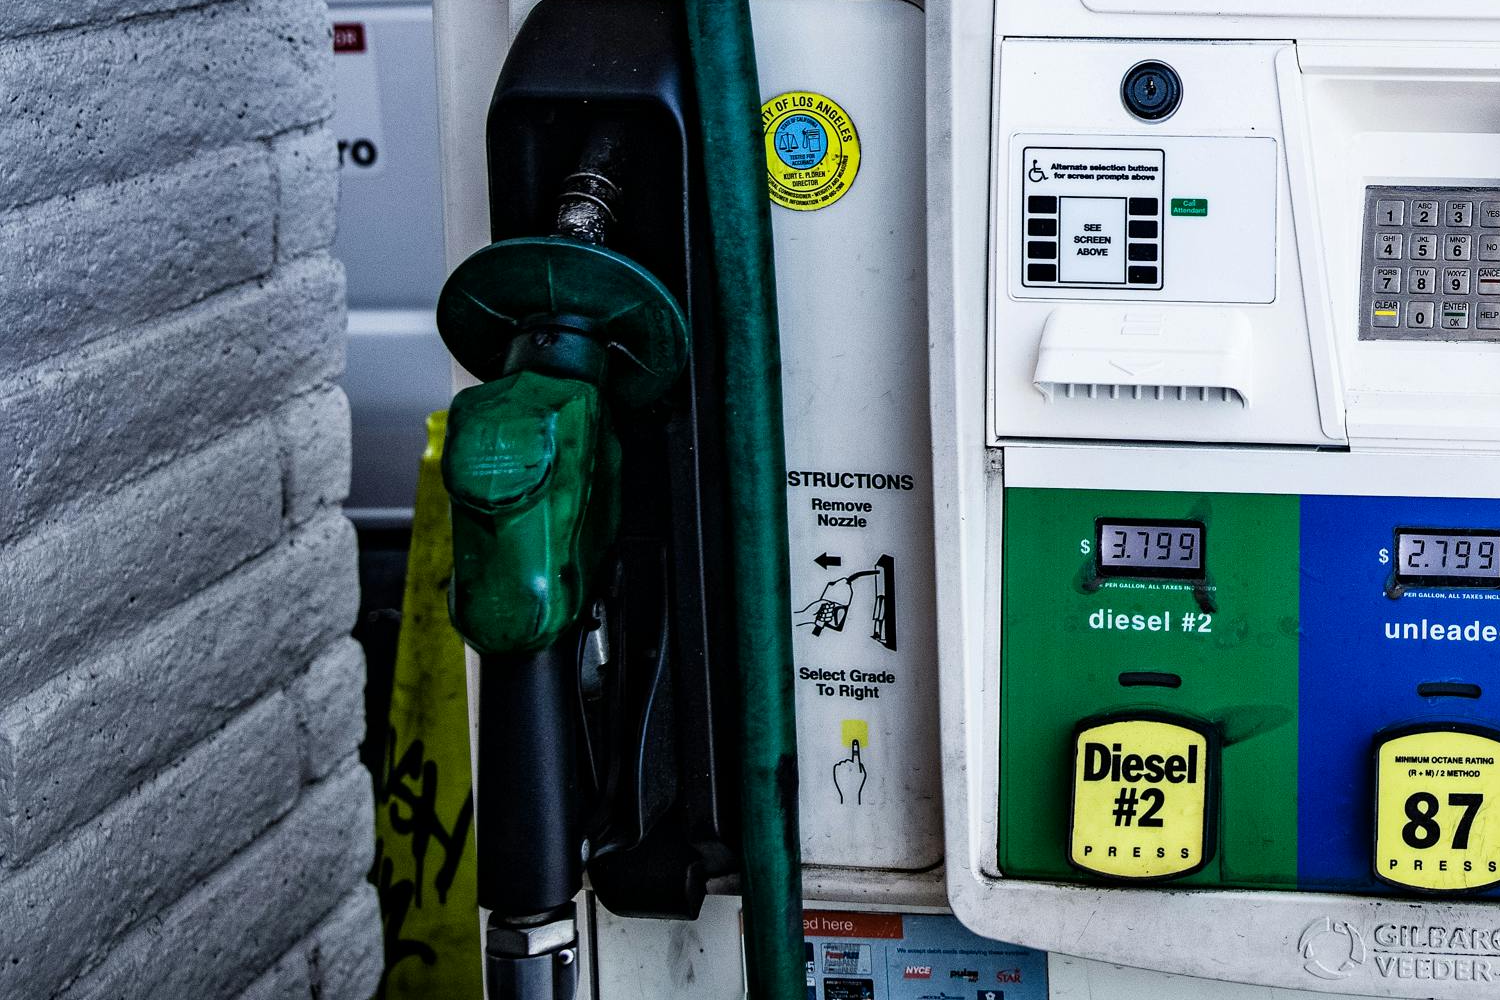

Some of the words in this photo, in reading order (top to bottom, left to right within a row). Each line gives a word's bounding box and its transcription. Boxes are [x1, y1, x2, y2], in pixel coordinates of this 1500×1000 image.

[1050, 163, 1088, 171] Alternate
[1089, 163, 1126, 172] selection
[1128, 164, 1159, 172] buttons
[1096, 173, 1129, 181] prompts
[1083, 224, 1102, 232] SEE
[1074, 236, 1111, 244] SCREEN
[1076, 248, 1109, 256] ABOVE
[1449, 318, 1460, 326] OK
[1480, 311, 1499, 319] HELP
[787, 471, 914, 490] STRUCTIONS
[811, 498, 872, 513] Remove
[817, 514, 867, 528] Nozzle
[1112, 531, 1194, 560] 3.799
[1408, 539, 1494, 570] 2.799
[1089, 609, 1170, 632] diesel
[1181, 612, 1212, 633] #2
[799, 667, 846, 683] Select
[849, 670, 895, 684] Grade
[816, 684, 834, 696] To
[839, 684, 880, 700] Right
[1083, 742, 1198, 784] Diesel
[1395, 756, 1429, 764] MINIMUM
[1431, 756, 1463, 764] OCTANE
[1465, 757, 1494, 765] RATING
[1112, 788, 1164, 827] #2
[1402, 792, 1484, 850] 87
[822, 918, 854, 931] here
[905, 966, 931, 976] NYCE
